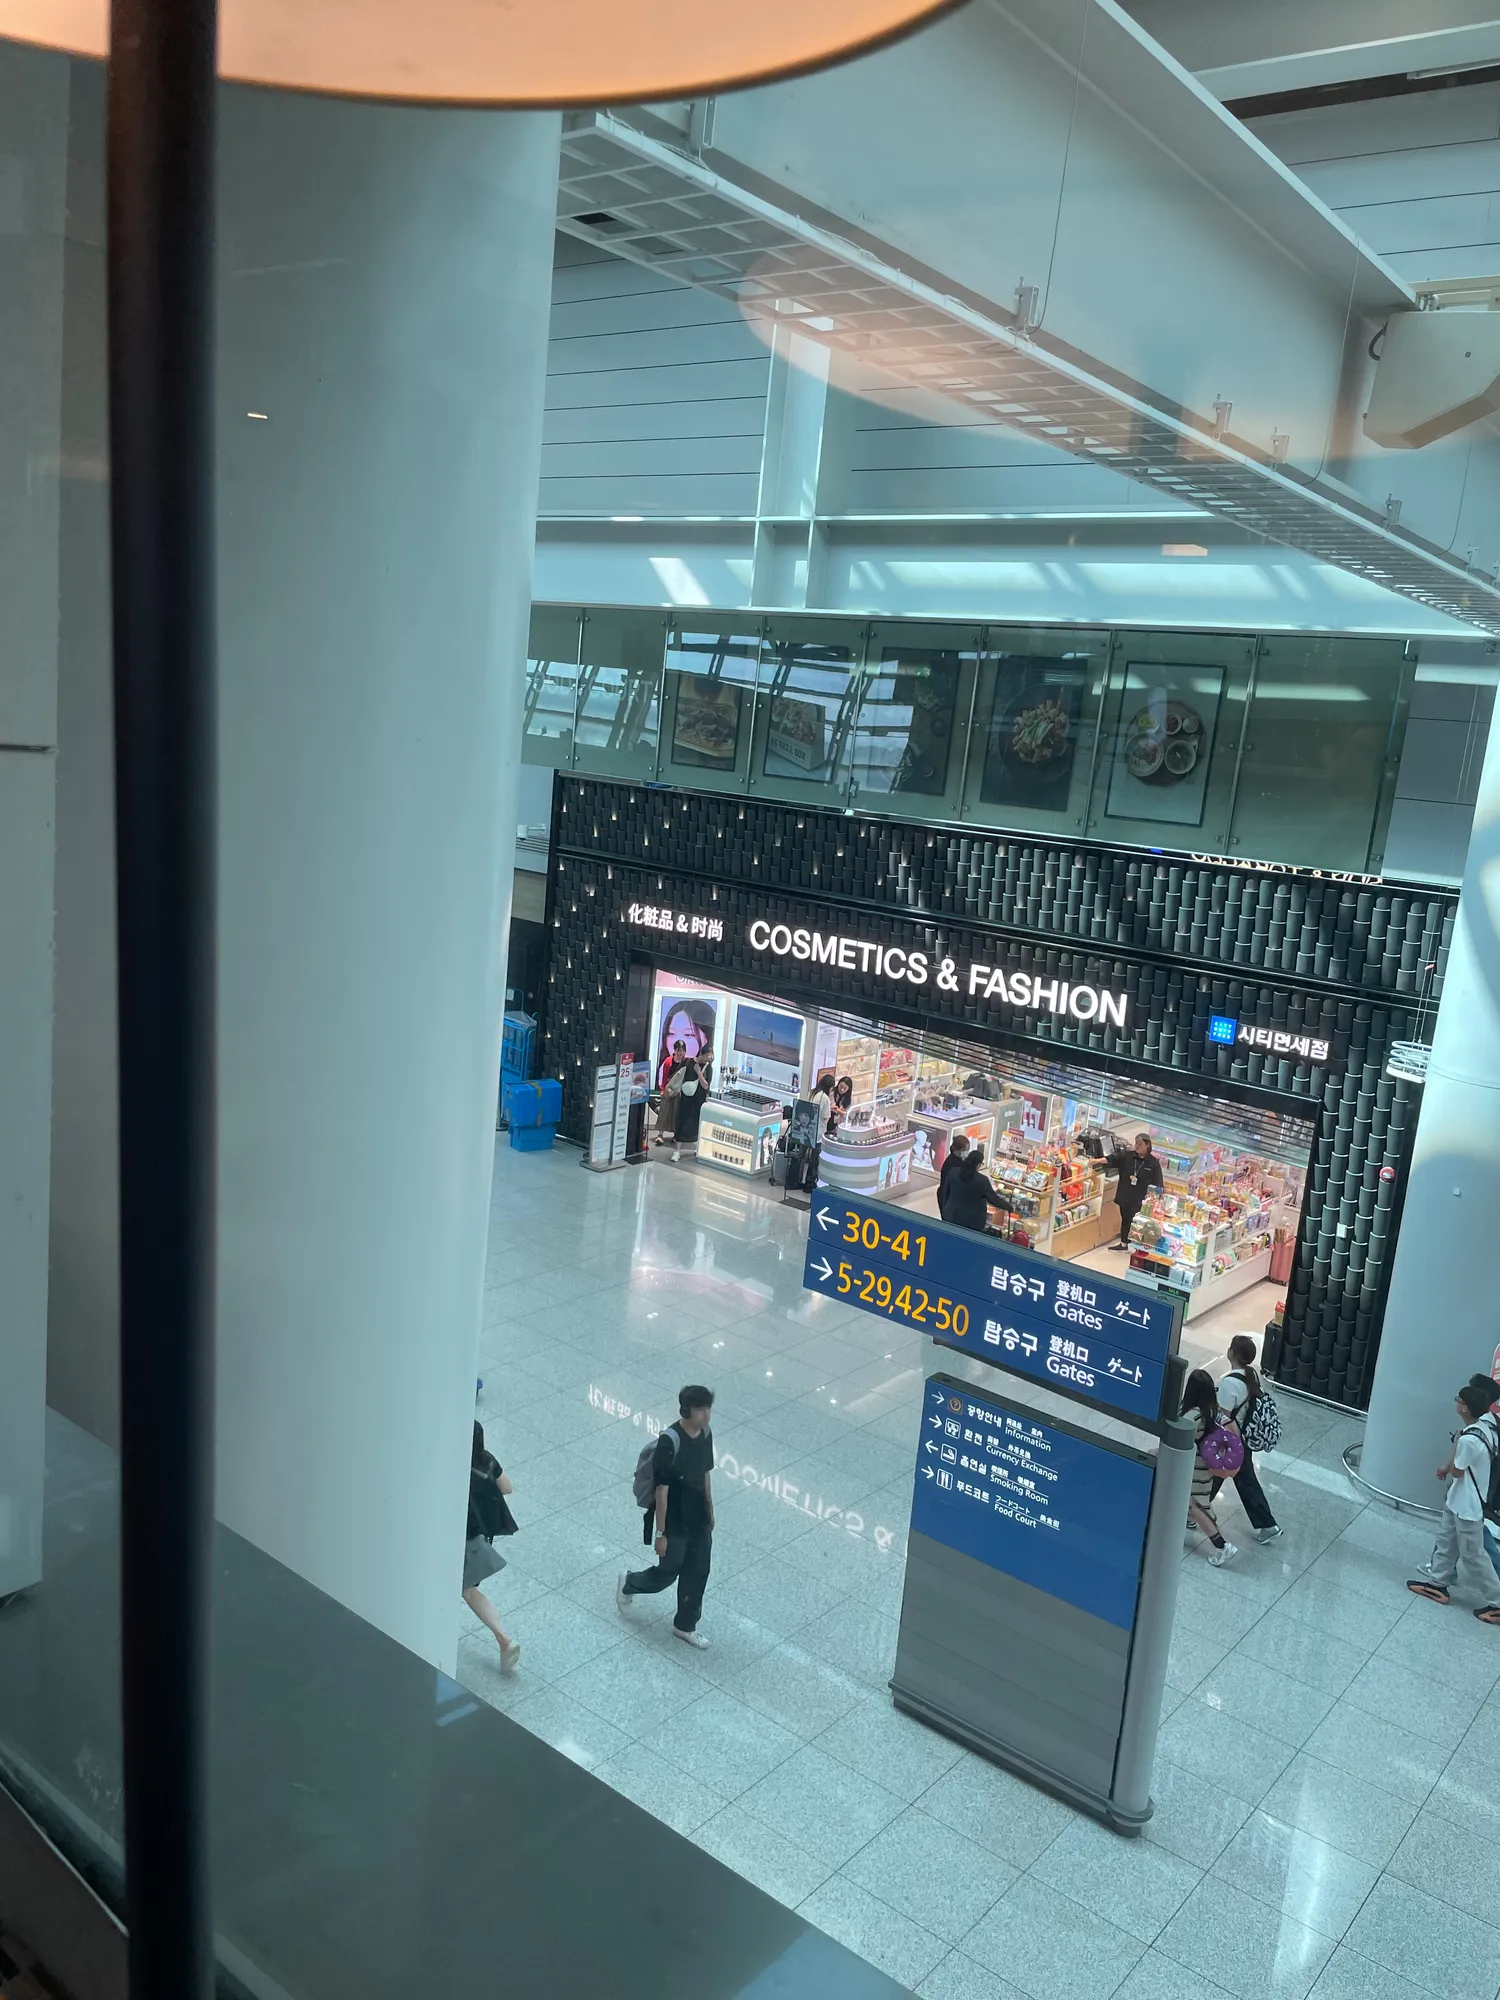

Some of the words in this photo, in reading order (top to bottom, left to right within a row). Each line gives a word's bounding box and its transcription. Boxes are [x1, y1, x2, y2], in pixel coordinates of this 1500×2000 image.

[628, 902, 673, 932] 化粧品
[676, 916, 689, 933] &
[691, 917, 724, 942] 时尚
[749, 920, 929, 985] COSMETICS
[936, 957, 960, 992] &
[968, 964, 1128, 1027] FASHION
[1237, 1026, 1329, 1060] 시티면세점
[842, 1211, 928, 1267] 30-41
[990, 1265, 1046, 1303] 탑승구
[1056, 1279, 1097, 1306] 登机口
[836, 1261, 970, 1338] 5-29,42-50
[1115, 1300, 1152, 1327] ゲート
[1054, 1302, 1103, 1332] Gates
[983, 1319, 1039, 1358] 탑승구
[1048, 1335, 1089, 1363] 登机口
[1046, 1357, 1096, 1388] Gates
[1107, 1357, 1144, 1384] ゲート
[967, 1404, 1003, 1428] 공항안내
[964, 1429, 983, 1446] 환전
[1005, 1426, 1052, 1452] Information
[985, 1445, 1020, 1466] Currency
[1020, 1459, 1058, 1482] Exchange
[956, 1480, 990, 1503] 푸드코트
[989, 1474, 1024, 1496] Smoking
[1025, 1487, 1049, 1506] Room
[994, 1503, 1014, 1518] Food
[1015, 1511, 1037, 1529] Court
